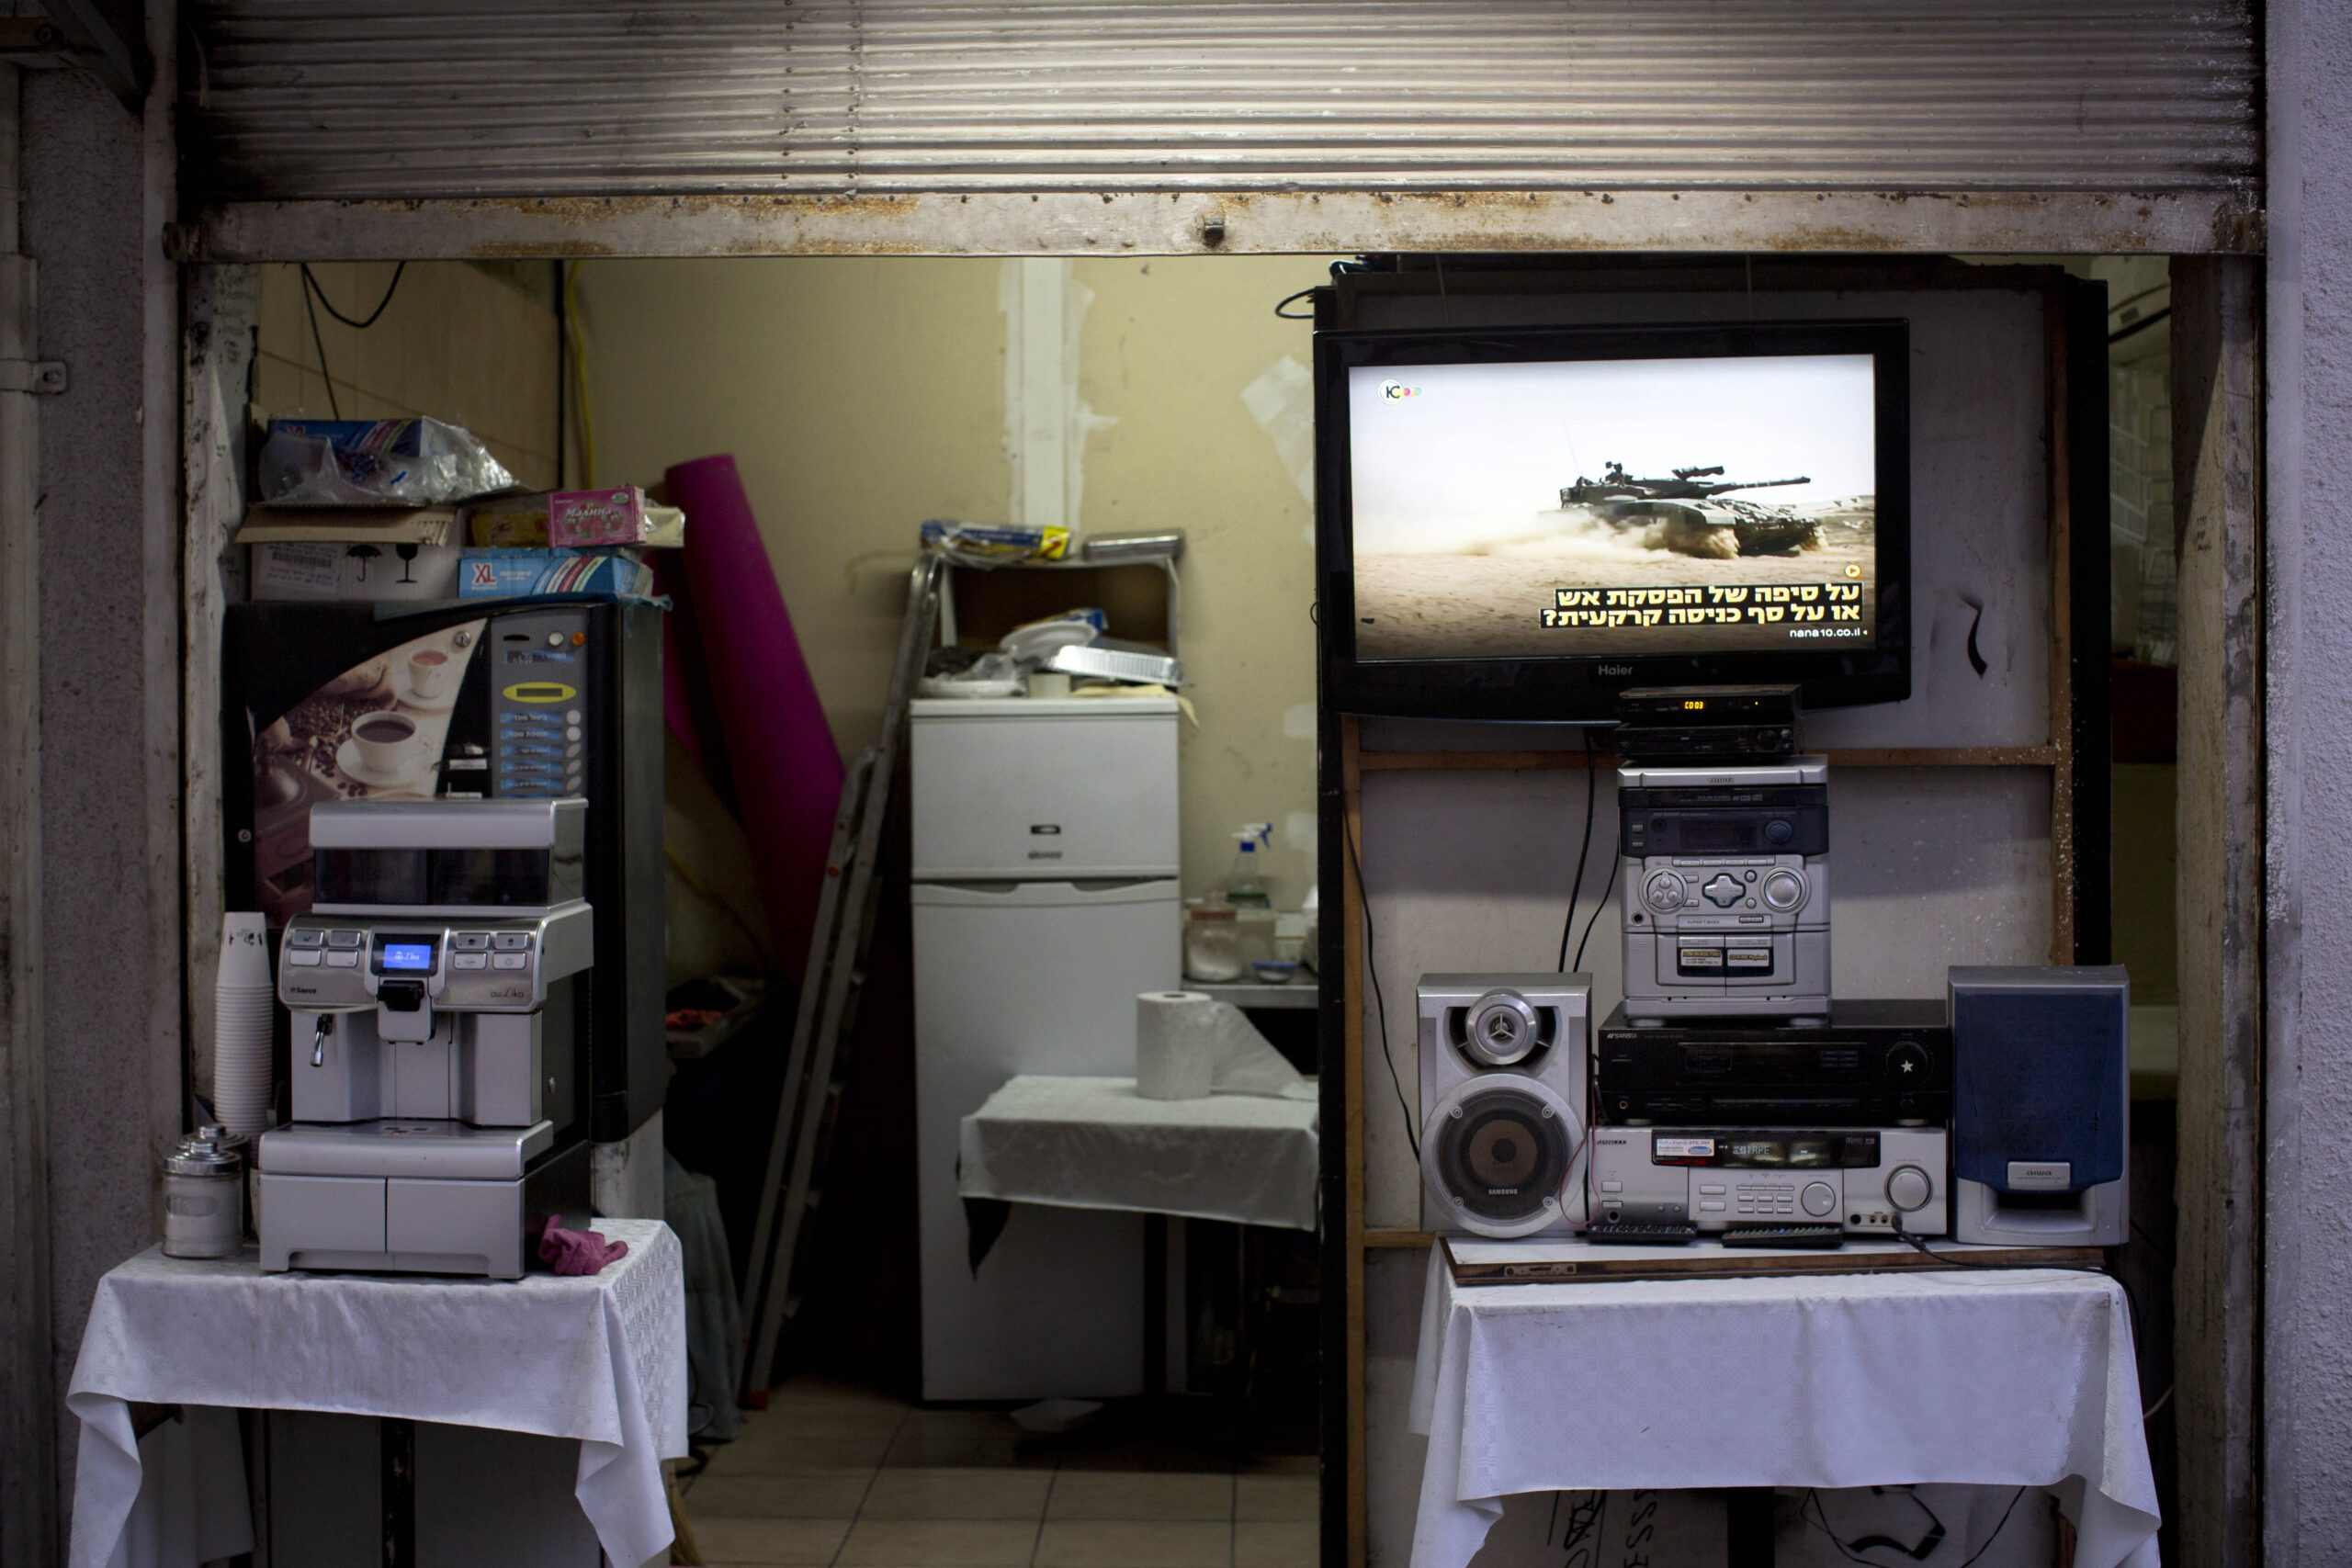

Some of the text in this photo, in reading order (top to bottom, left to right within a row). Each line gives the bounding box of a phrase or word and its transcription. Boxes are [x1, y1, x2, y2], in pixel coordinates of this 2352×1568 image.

[472, 562, 497, 584] XL
[1557, 582, 1860, 608] על סיפה של הפסקת אש
[1543, 604, 1860, 628] או על סף כניסה קרקעית?
[1789, 627, 1860, 638] nana10.co.il
[1598, 665, 1634, 676] Haier
[296, 987, 317, 995] Saeco
